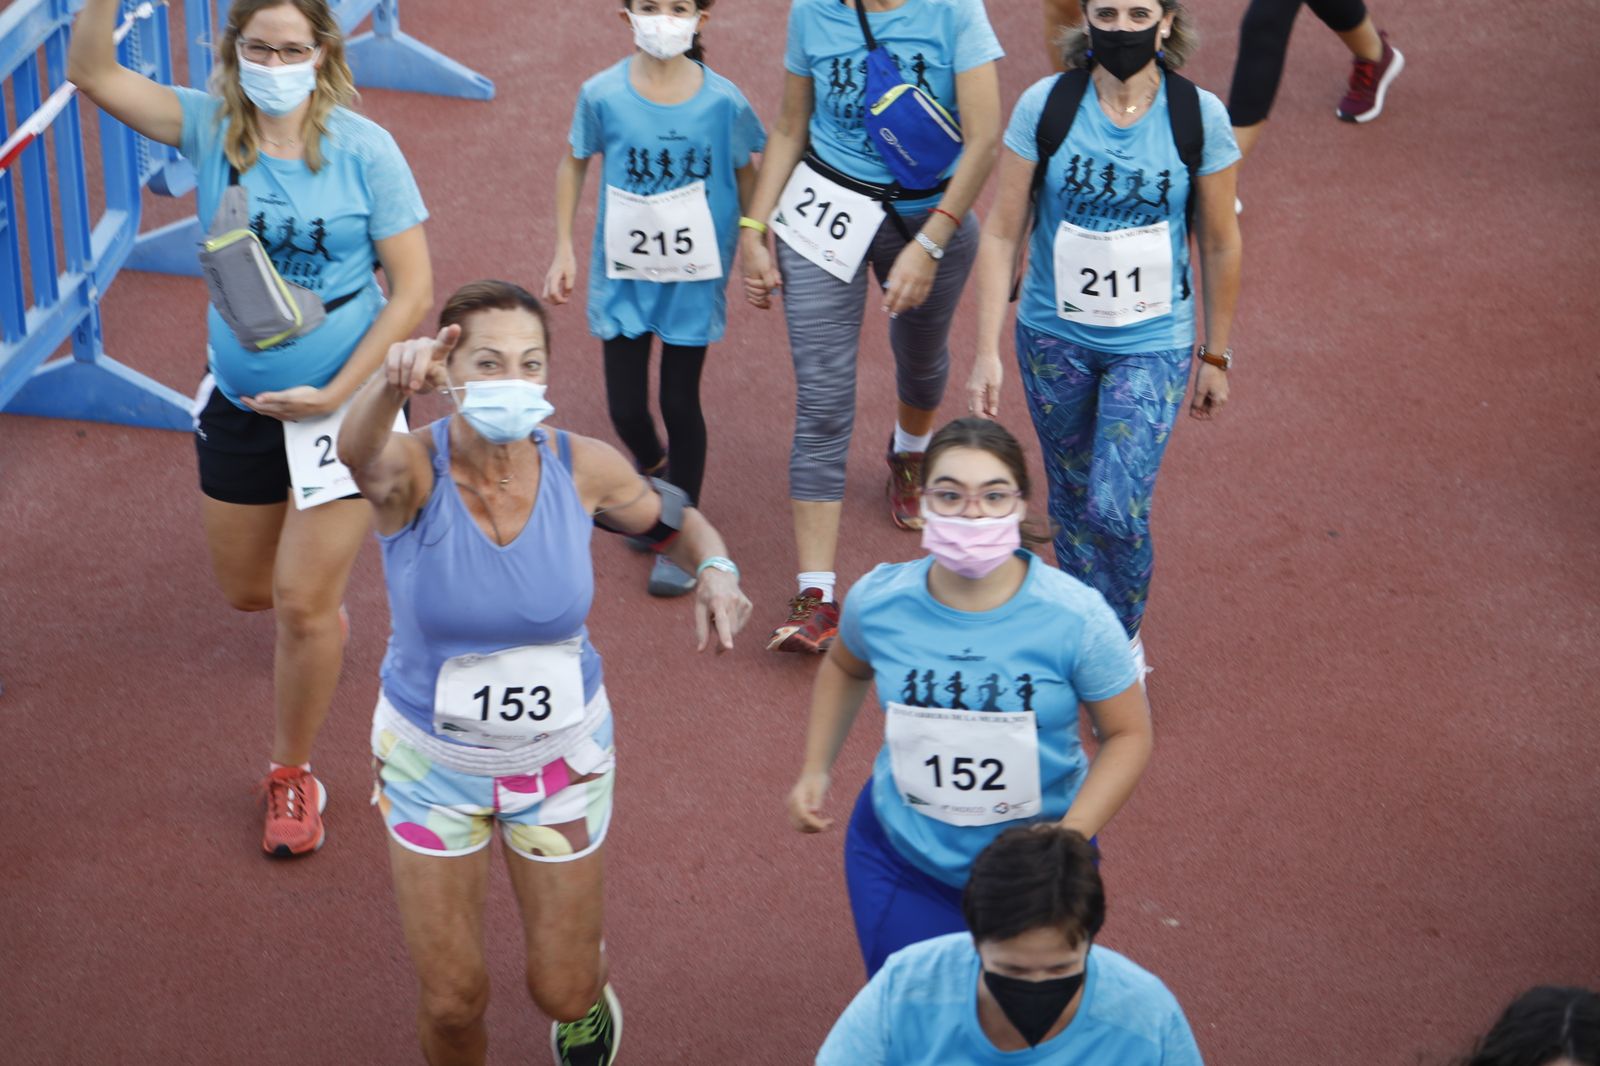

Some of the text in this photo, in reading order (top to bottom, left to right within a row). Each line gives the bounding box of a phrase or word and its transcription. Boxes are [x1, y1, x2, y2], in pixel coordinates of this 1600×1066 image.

[795, 187, 851, 240] 216
[630, 227, 693, 256] 215
[1080, 266, 1141, 298] 211
[314, 434, 337, 468] 2
[473, 685, 552, 721] 153
[924, 755, 1007, 791] 152
